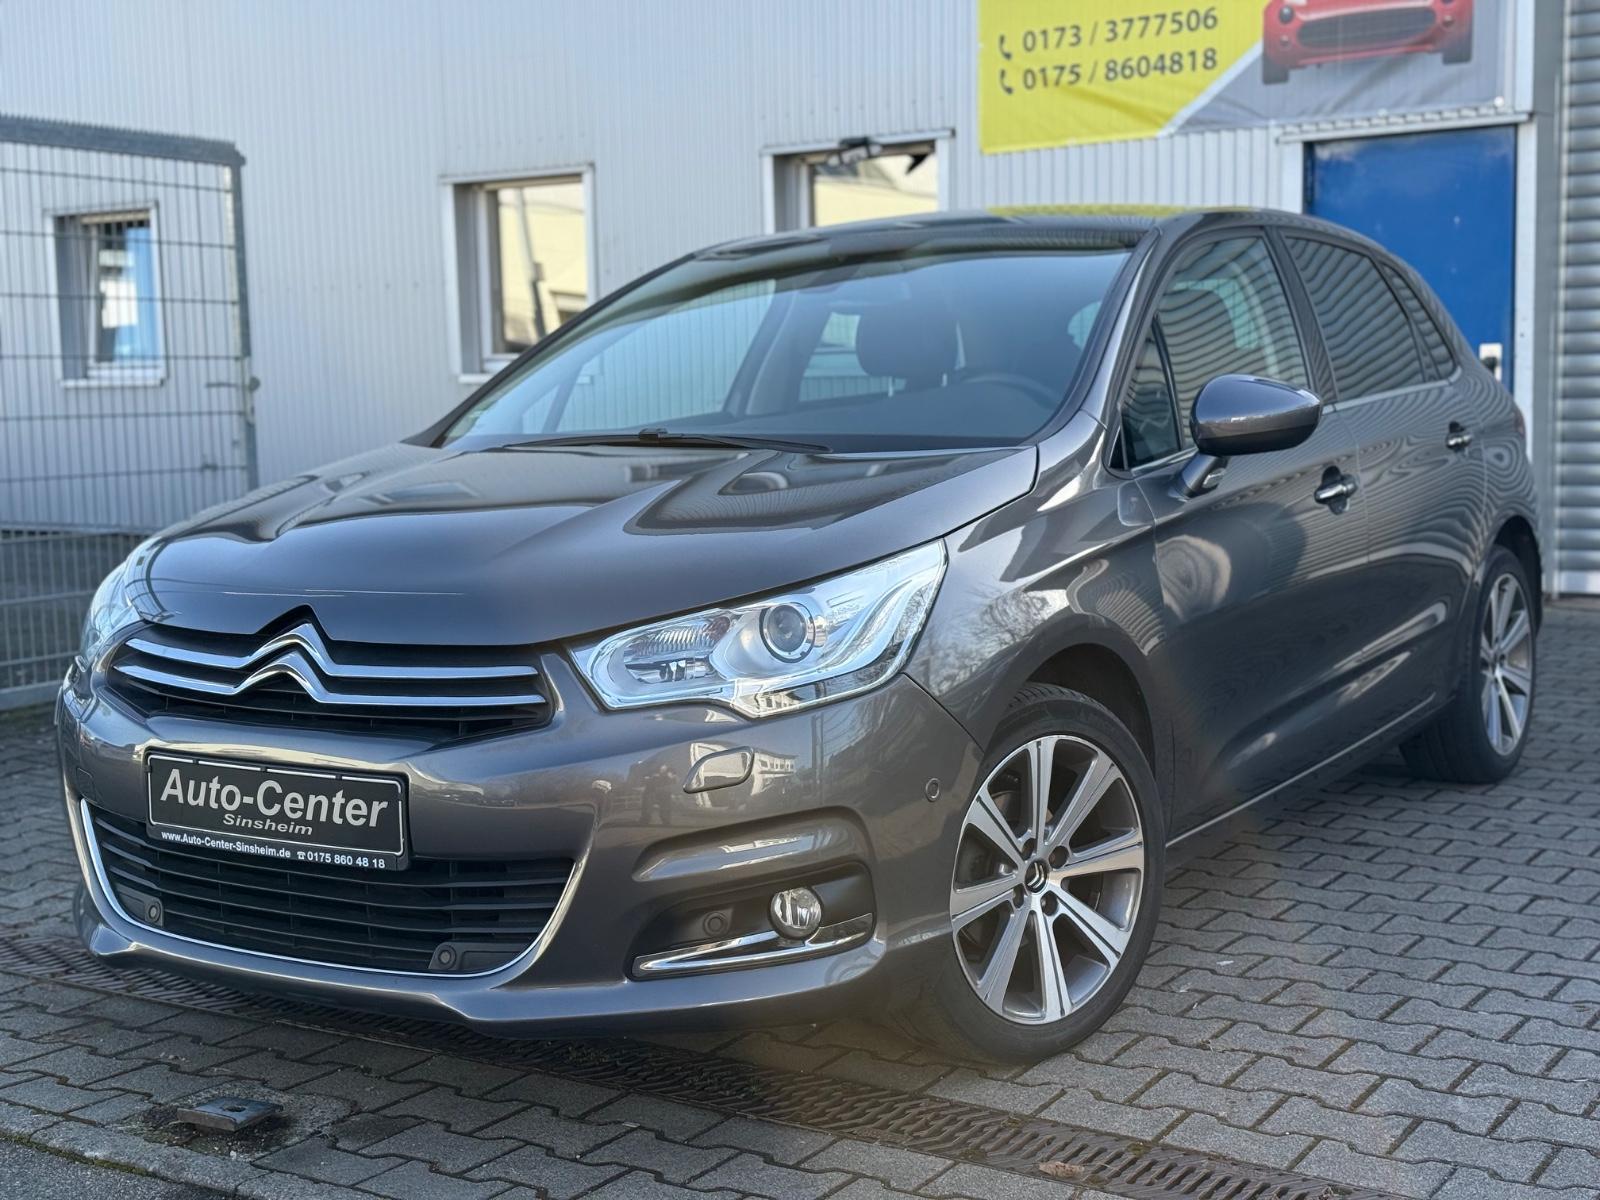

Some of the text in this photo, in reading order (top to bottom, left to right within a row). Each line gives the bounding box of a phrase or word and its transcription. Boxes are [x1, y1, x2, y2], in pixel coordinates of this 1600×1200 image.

[1022, 25, 1082, 52] 0173
[1105, 7, 1218, 43] 3777506
[1023, 64, 1081, 90] 0175
[1104, 47, 1218, 82] 8604818
[160, 768, 388, 828] Auto-Center
[223, 813, 313, 836] Sinsheim
[161, 830, 385, 869] www.Auto-Center-Sinsheim.de 0175 860 48 18
